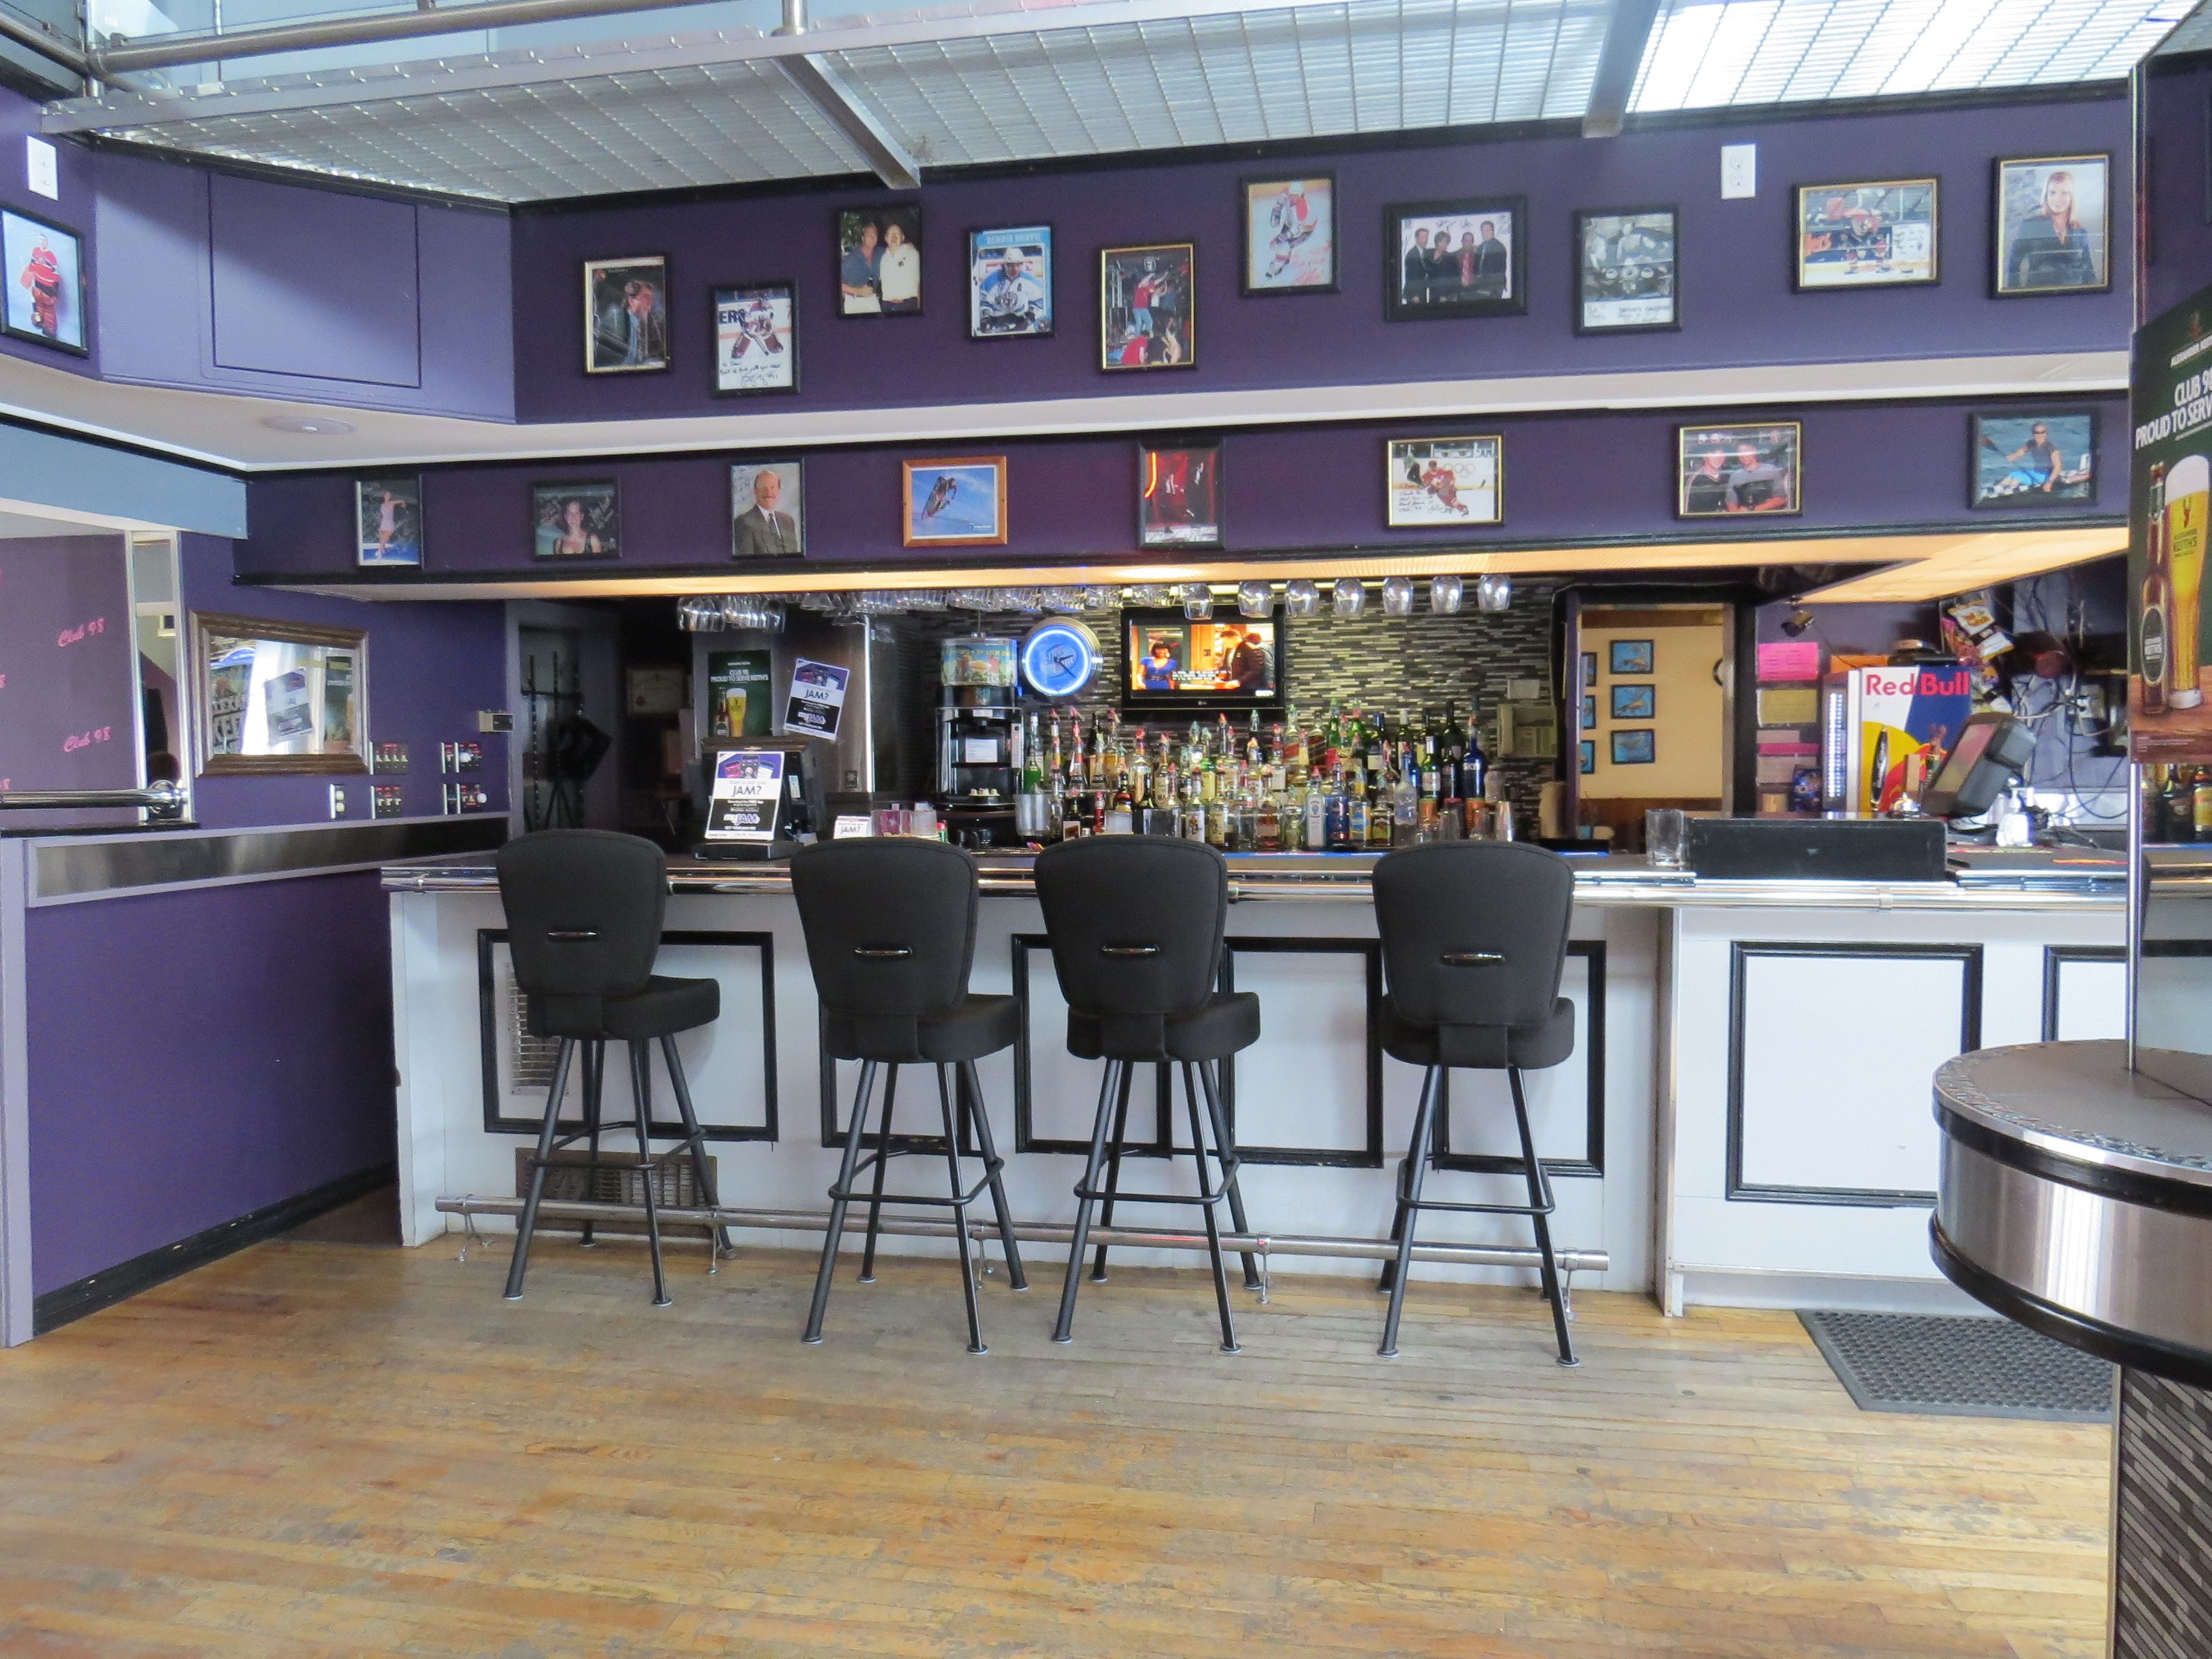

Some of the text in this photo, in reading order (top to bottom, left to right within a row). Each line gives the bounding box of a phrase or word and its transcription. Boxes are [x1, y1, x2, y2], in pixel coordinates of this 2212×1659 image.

[2174, 374, 2200, 407] CLUB
[2135, 393, 2212, 450] PROUD TO SERV
[59, 618, 105, 647] Club 98
[804, 690, 830, 700] JAM?
[1866, 672, 1969, 696] Red Bull
[64, 726, 111, 753] Club 98
[731, 786, 762, 797] JAM?
[723, 813, 760, 825] myJAM
